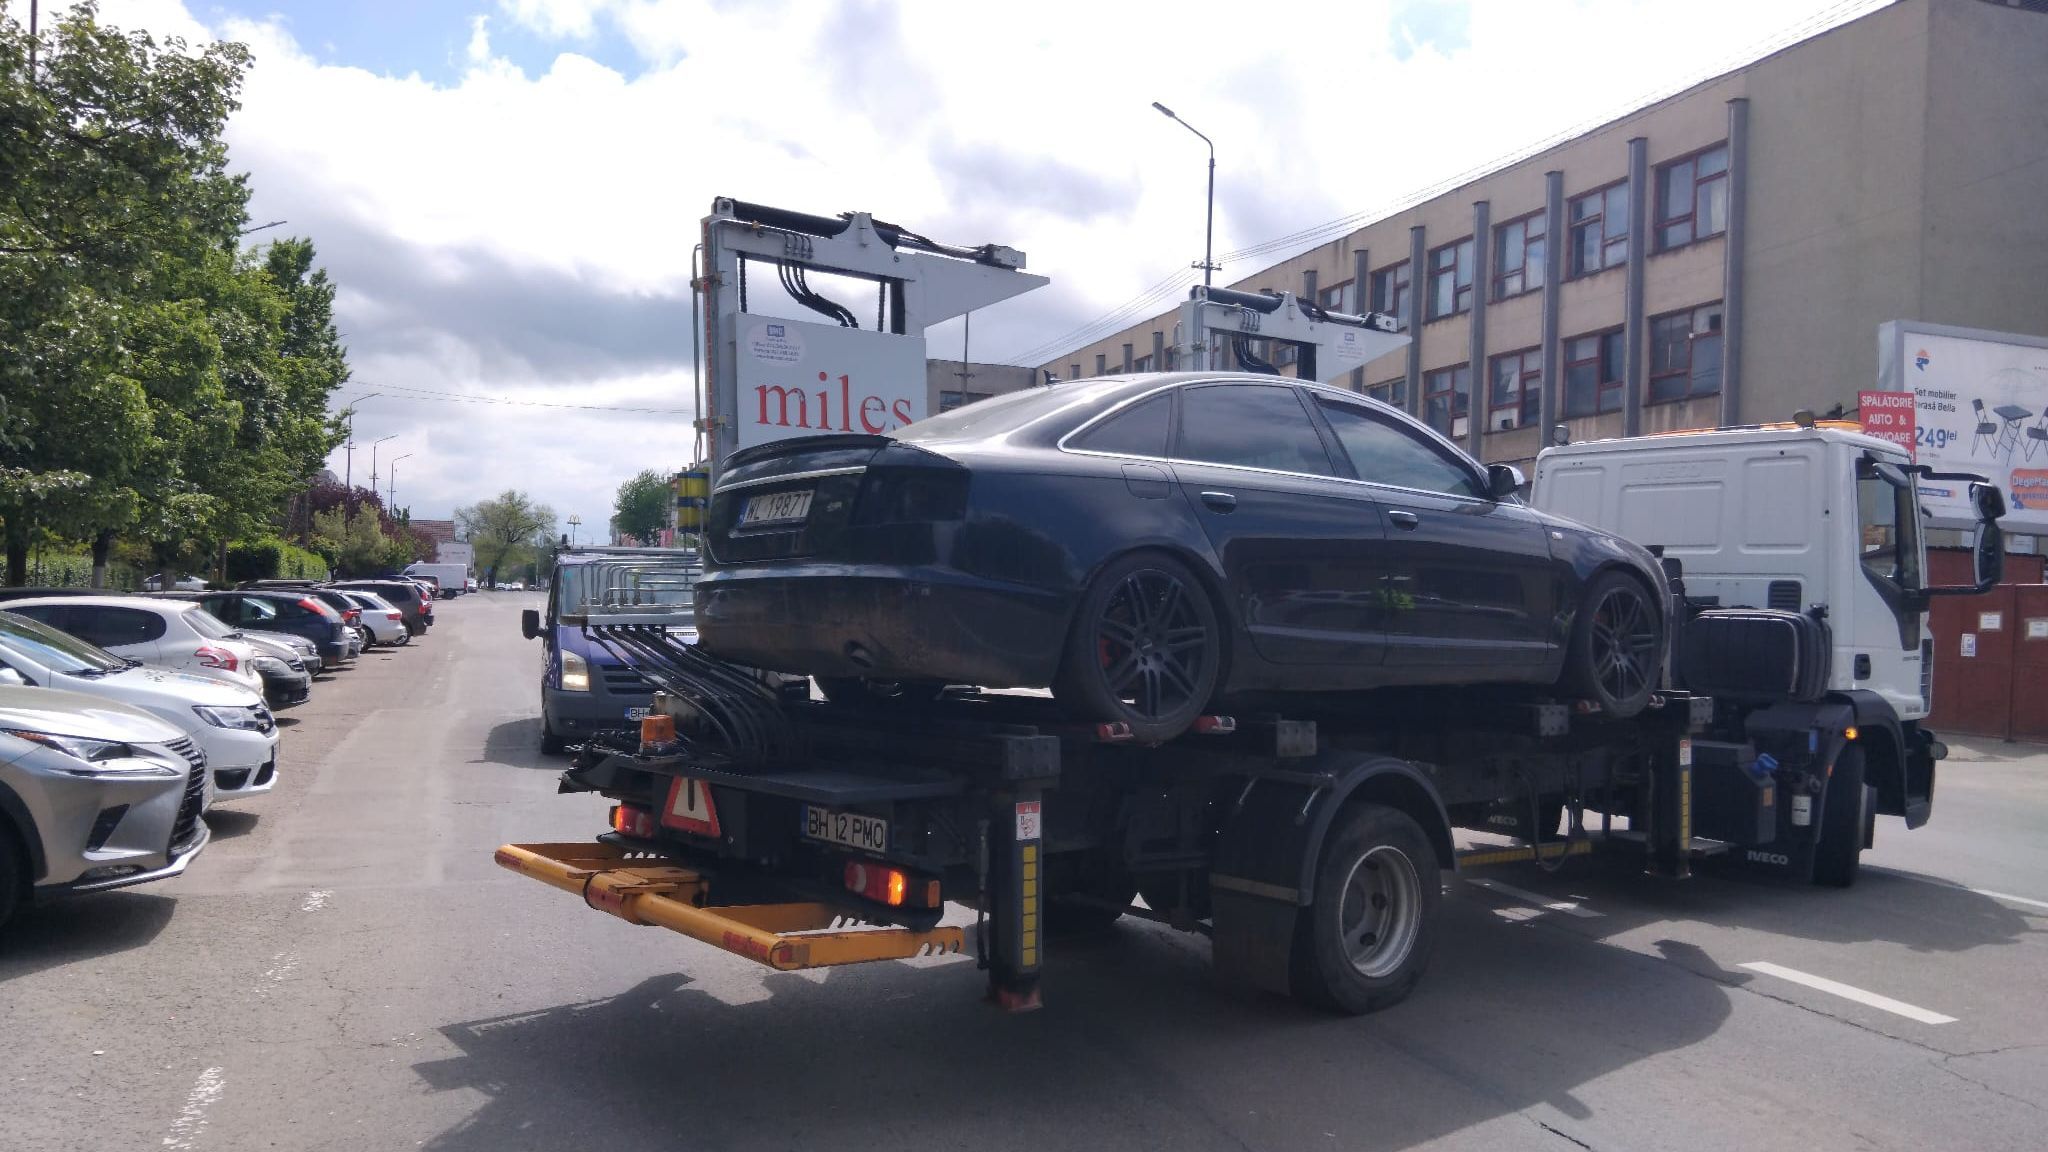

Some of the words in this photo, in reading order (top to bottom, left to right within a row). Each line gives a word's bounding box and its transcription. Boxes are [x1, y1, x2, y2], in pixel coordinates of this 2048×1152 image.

[755, 371, 913, 435] miles
[1914, 387, 1926, 397] Set
[1868, 413, 1893, 425] AUTO
[1899, 414, 1907, 425] &
[1915, 426, 1946, 448] 249
[1946, 430, 1958, 441] lei
[747, 497, 760, 520] WL
[767, 492, 811, 518] 1987T
[808, 809, 829, 838] BH
[835, 814, 848, 841] 12
[852, 818, 884, 849] PMO
[1747, 850, 1789, 865] IVECO
